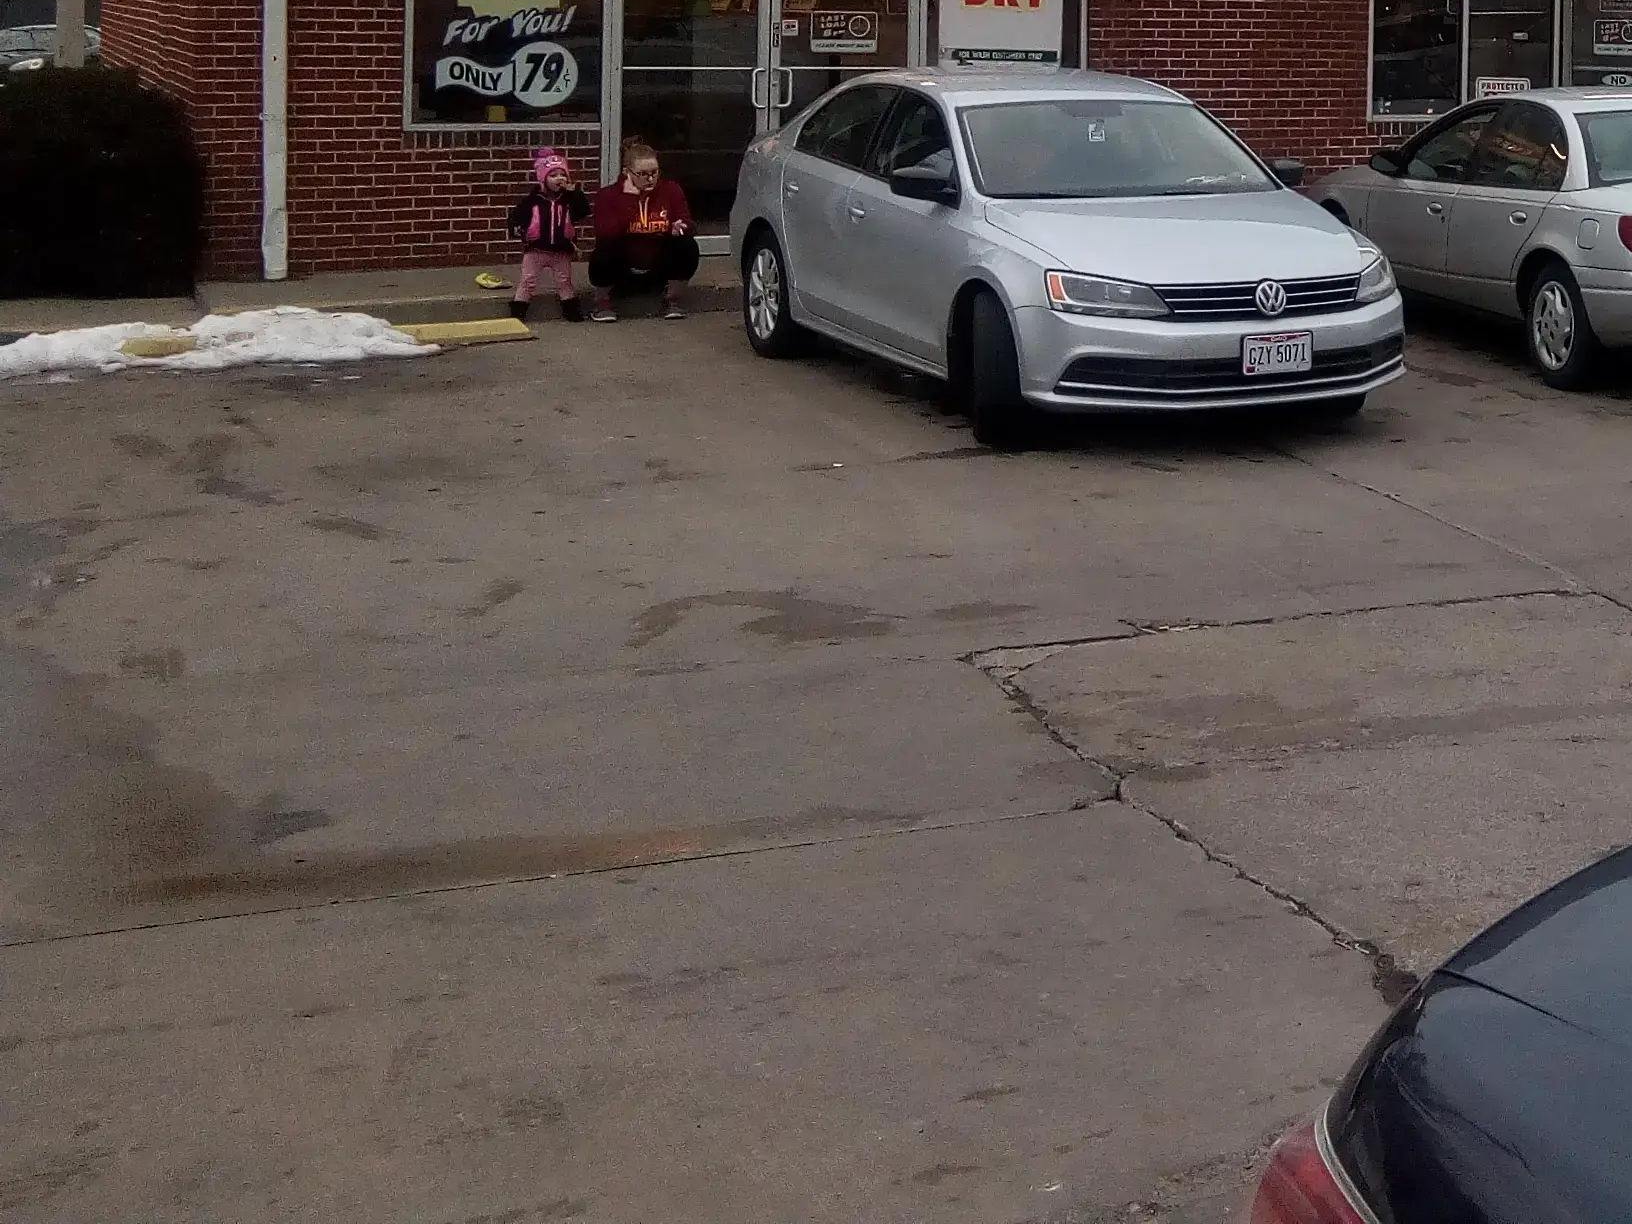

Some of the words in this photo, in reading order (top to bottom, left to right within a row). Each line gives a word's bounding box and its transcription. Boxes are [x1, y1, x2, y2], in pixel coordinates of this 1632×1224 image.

[443, 19, 498, 46] For
[511, 5, 577, 38] You!
[449, 62, 502, 91] ONLY
[1611, 76, 1627, 85] NO
[1249, 347, 1272, 365] GZY
[1276, 343, 1307, 362] 5071
